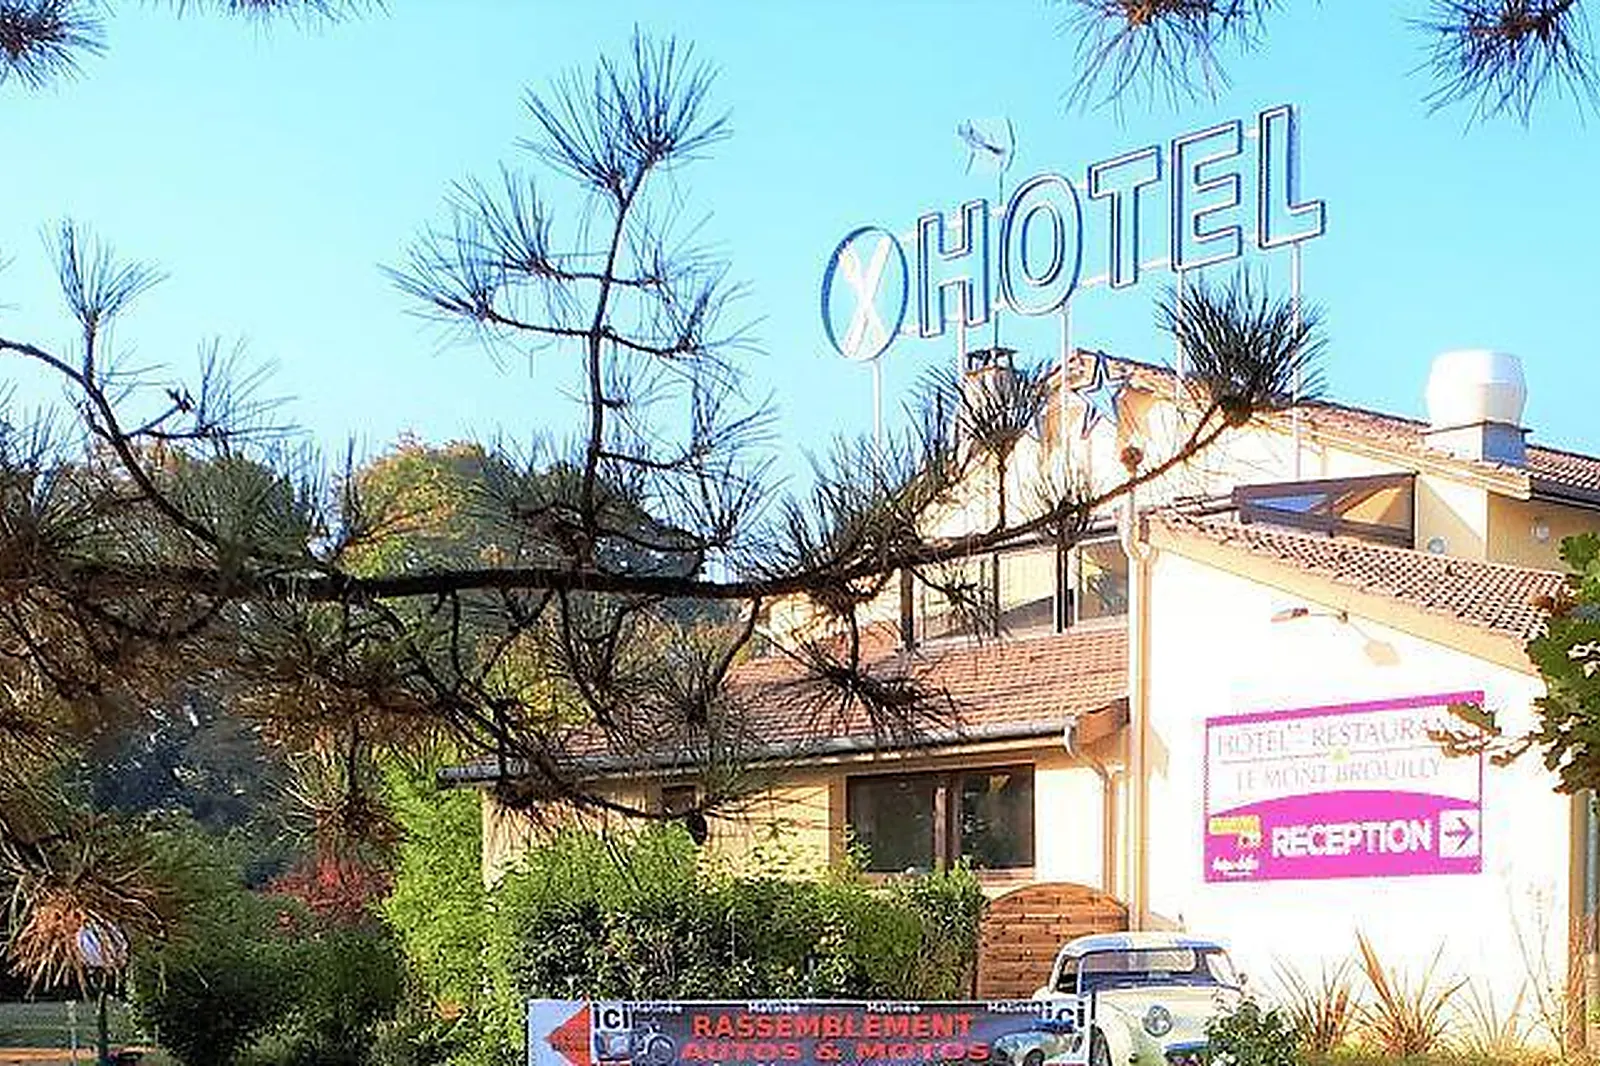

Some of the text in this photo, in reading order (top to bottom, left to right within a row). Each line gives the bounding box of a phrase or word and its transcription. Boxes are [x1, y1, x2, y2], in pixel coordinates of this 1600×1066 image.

[918, 104, 1326, 338] HOTEL
[1271, 820, 1433, 857] RECEPTION
[692, 1013, 973, 1038] RASSEMBLEMENT
[680, 1040, 991, 1061] AUTOS & MOTOS
